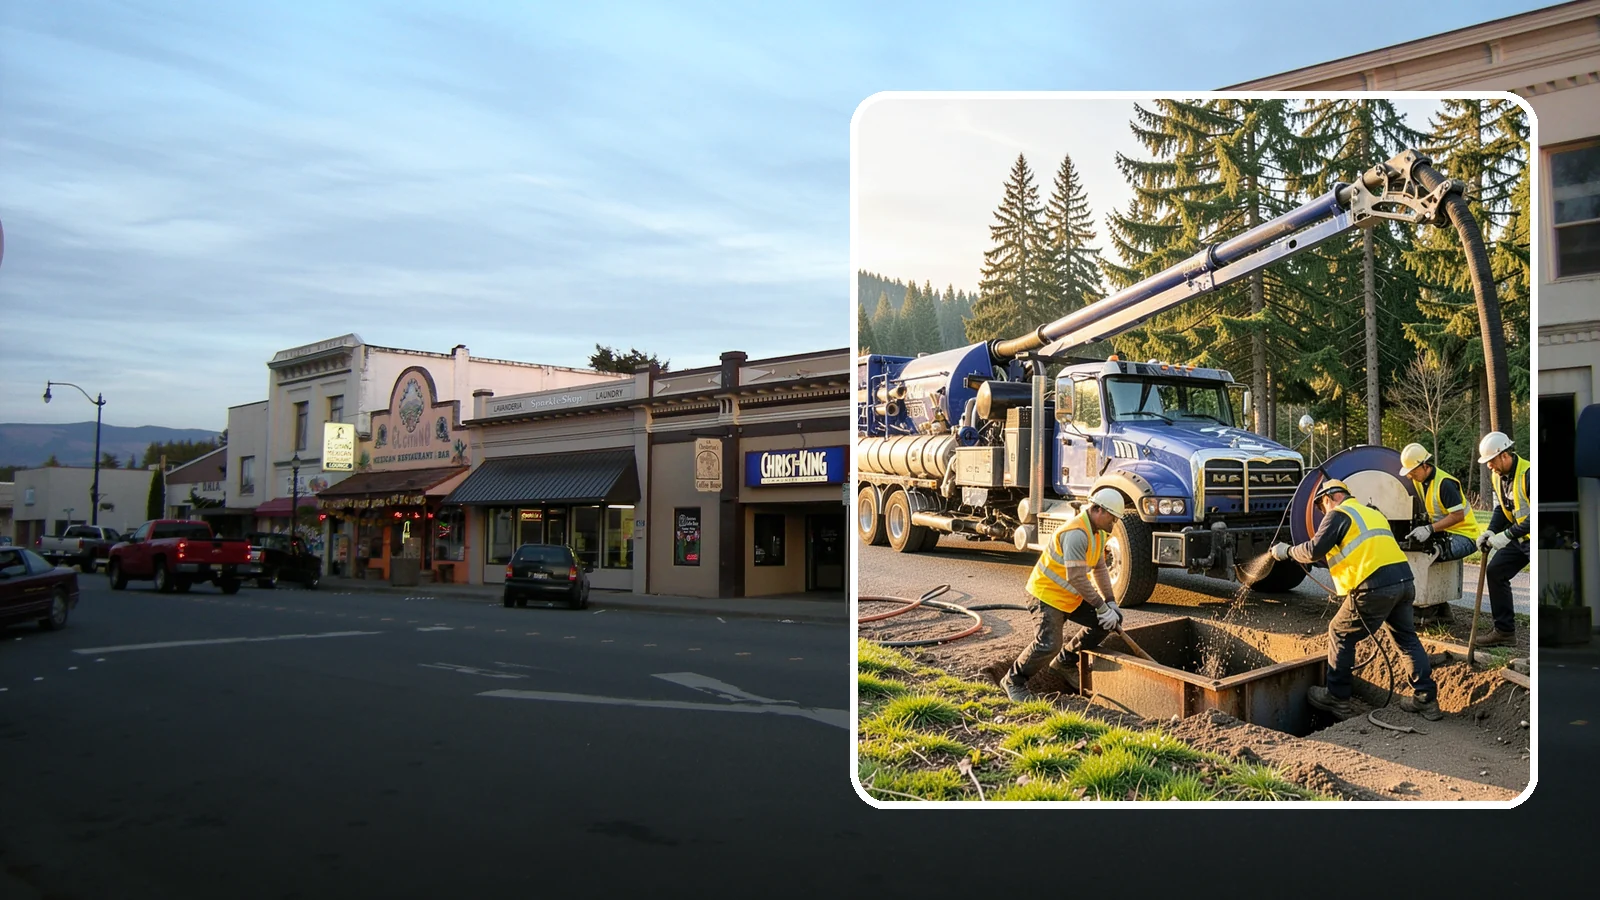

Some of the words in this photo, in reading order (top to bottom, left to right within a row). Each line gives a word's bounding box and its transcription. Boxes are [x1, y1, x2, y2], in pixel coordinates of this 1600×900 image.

[595, 389, 623, 400] LAUNDRY
[494, 402, 523, 412] LAVANDERIA
[530, 396, 561, 409] Sparkle
[561, 394, 583, 404] Shop
[397, 451, 433, 462] RESTAURANT
[437, 450, 450, 459] BAR
[760, 452, 797, 478] CHRIST
[799, 450, 827, 476] KING
